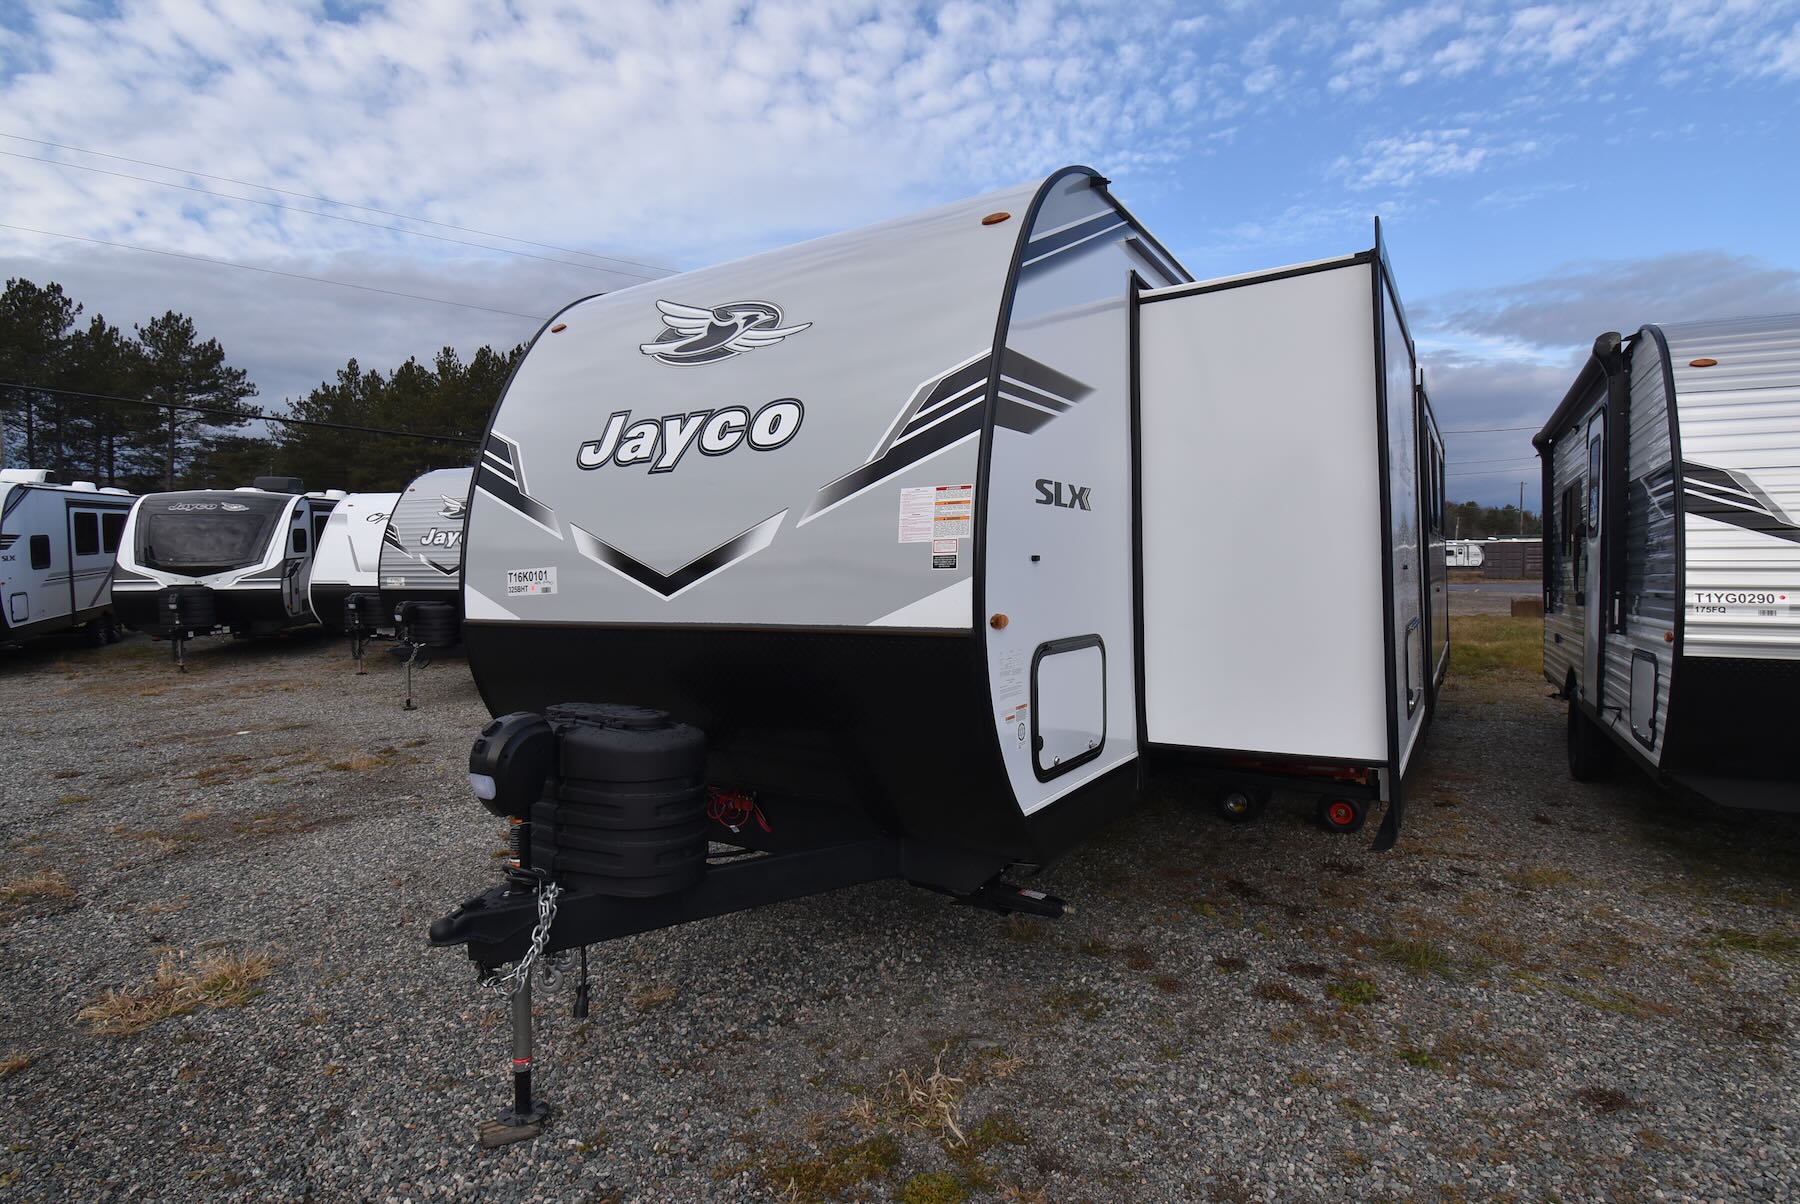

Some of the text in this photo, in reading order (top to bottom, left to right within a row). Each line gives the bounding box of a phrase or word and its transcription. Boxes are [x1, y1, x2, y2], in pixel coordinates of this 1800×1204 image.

[576, 397, 804, 475] Jayco
[1035, 478, 1092, 512] SLX
[168, 502, 217, 511] Jayco
[508, 570, 548, 583] T16K0101
[1694, 592, 1776, 604] T1YG0290
[1694, 605, 1727, 614] 175FQ
